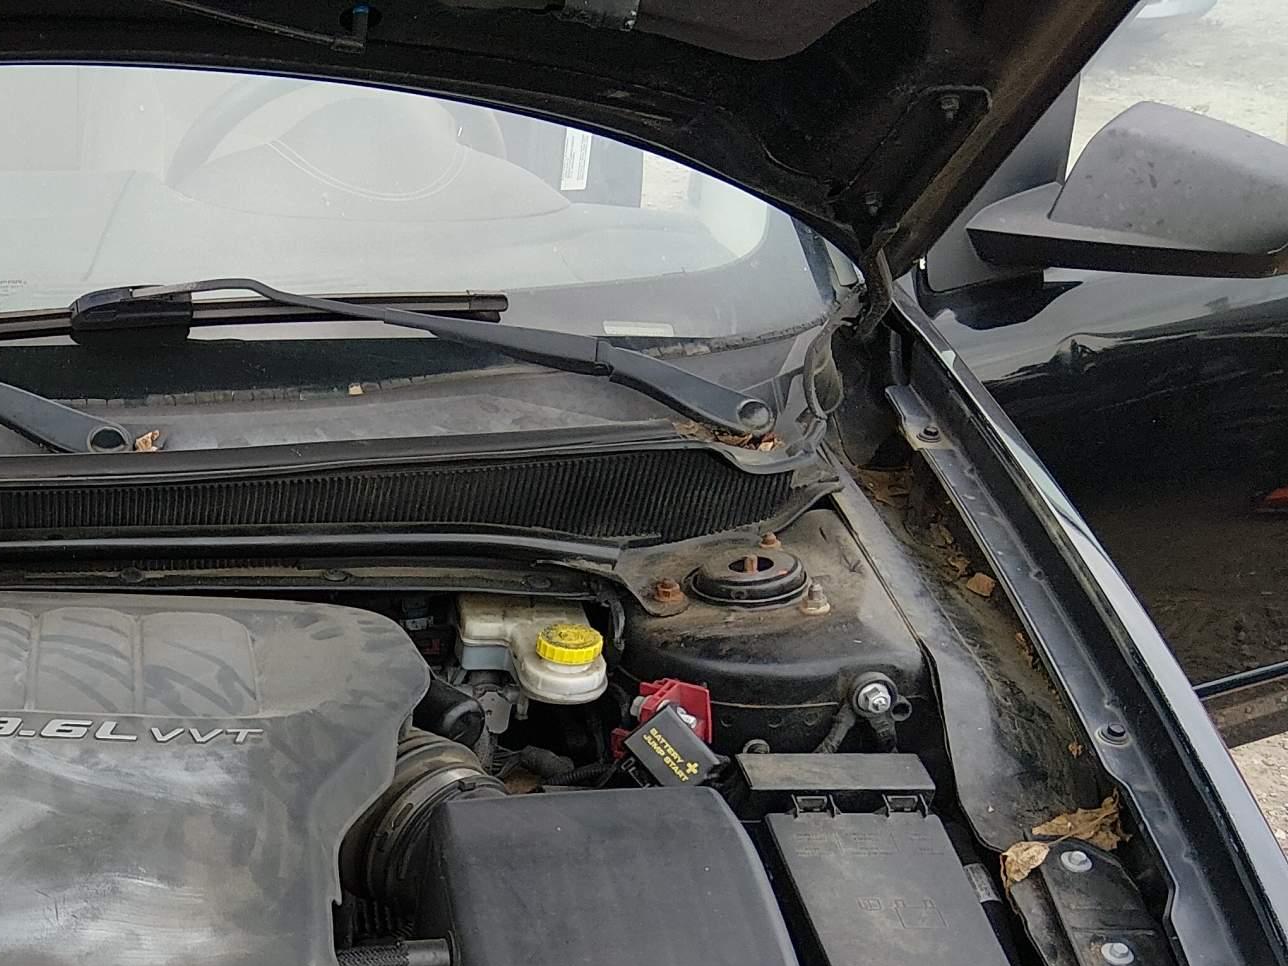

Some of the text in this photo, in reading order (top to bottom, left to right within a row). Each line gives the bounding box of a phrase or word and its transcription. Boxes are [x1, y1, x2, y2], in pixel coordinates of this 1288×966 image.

[150, 727, 265, 744] VVT
[649, 728, 685, 764] BATTERY
[643, 734, 689, 782] JUMP START
